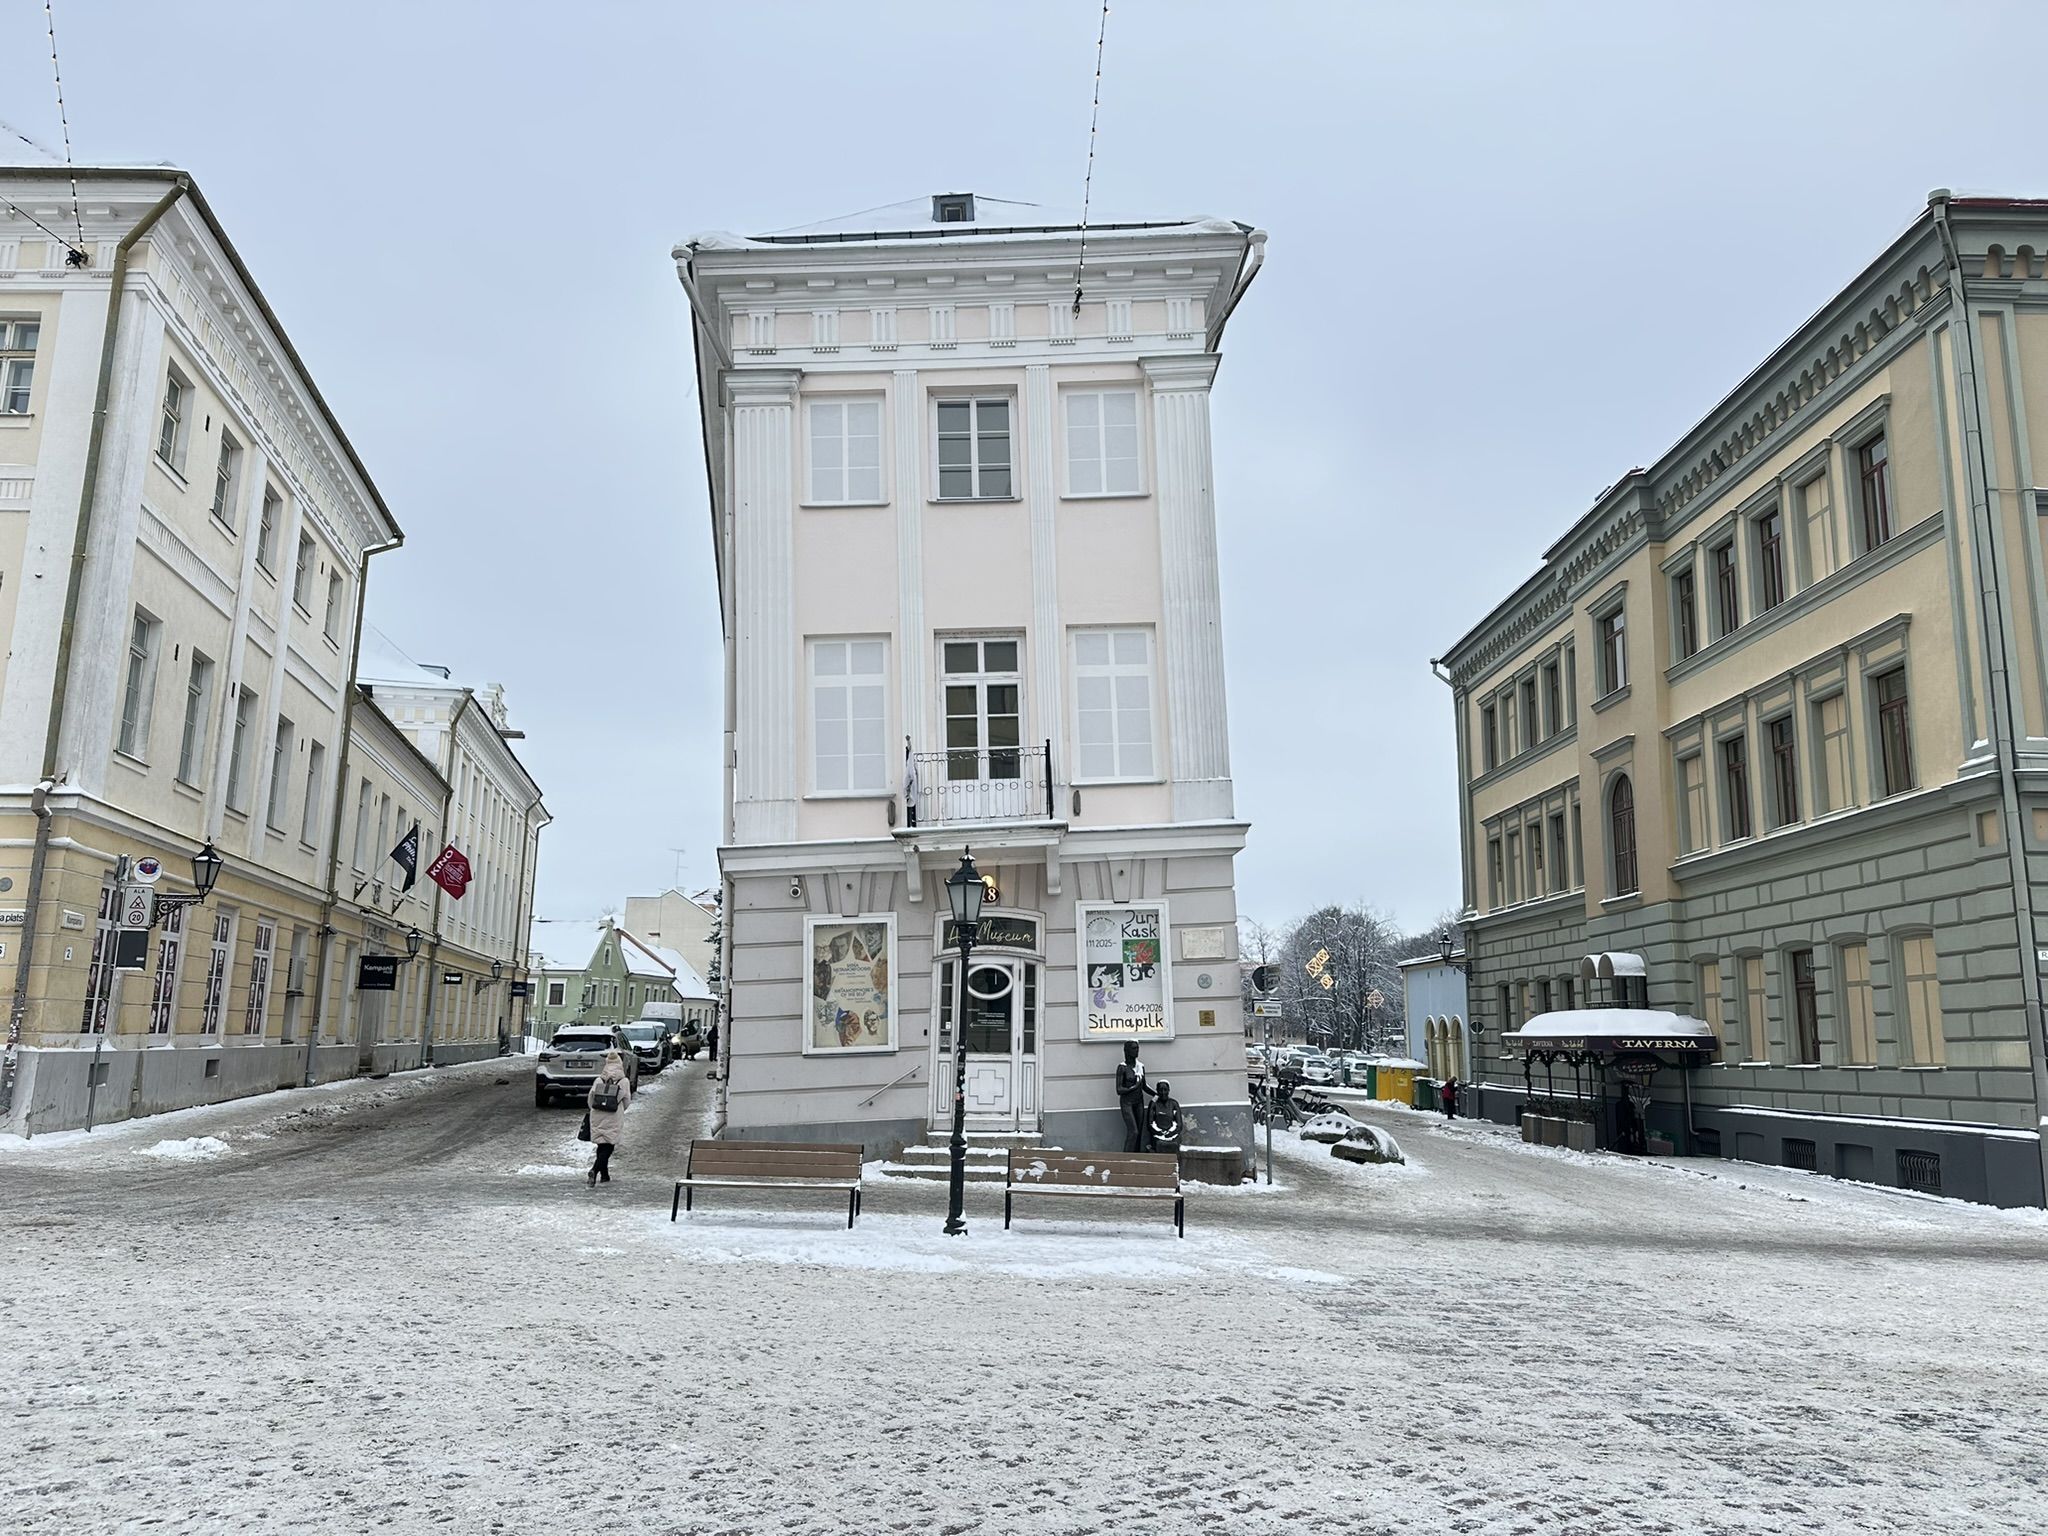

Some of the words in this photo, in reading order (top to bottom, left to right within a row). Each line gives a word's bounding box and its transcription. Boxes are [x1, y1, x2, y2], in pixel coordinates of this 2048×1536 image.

[430, 849, 454, 877] KINO
[5, 912, 24, 923] plats
[132, 913, 141, 922] 20
[1121, 923, 1157, 938] Kask
[66, 948, 71, 959] 2
[1622, 1039, 1698, 1049] TAVERNA
